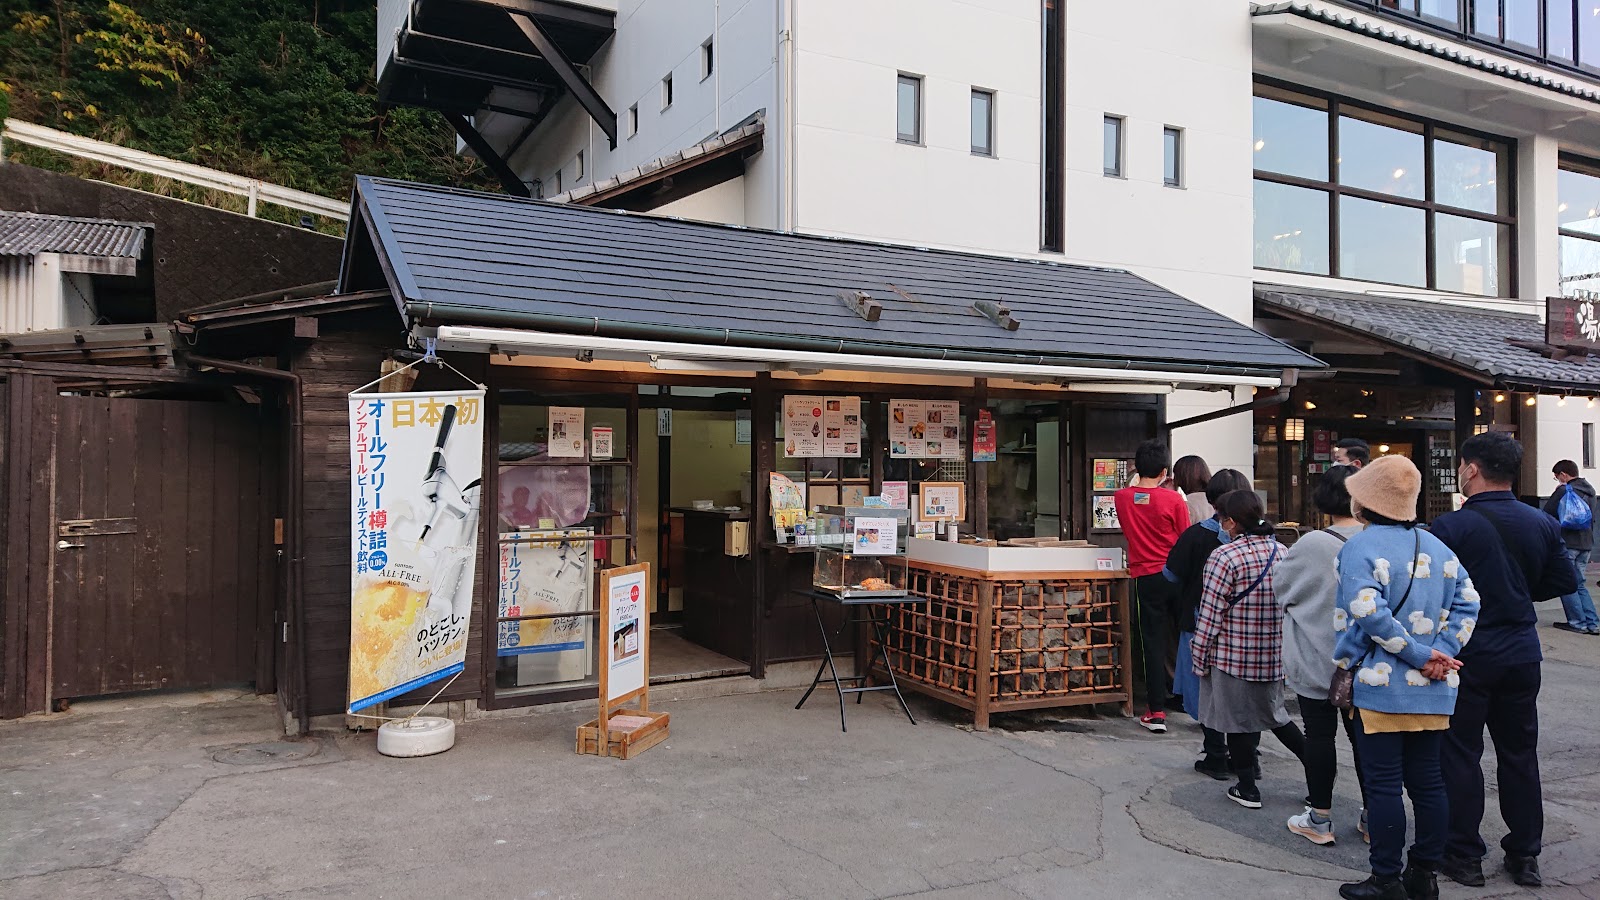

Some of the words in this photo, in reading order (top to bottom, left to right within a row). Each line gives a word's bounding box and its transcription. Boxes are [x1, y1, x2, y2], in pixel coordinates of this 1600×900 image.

[1576, 300, 1600, 343] 湯
[392, 397, 479, 428] 日本初
[357, 400, 368, 574] ノンアルコールビールテイスト飲料
[368, 399, 387, 550] オールフリー樽詰
[378, 569, 421, 583] ALL-FREE
